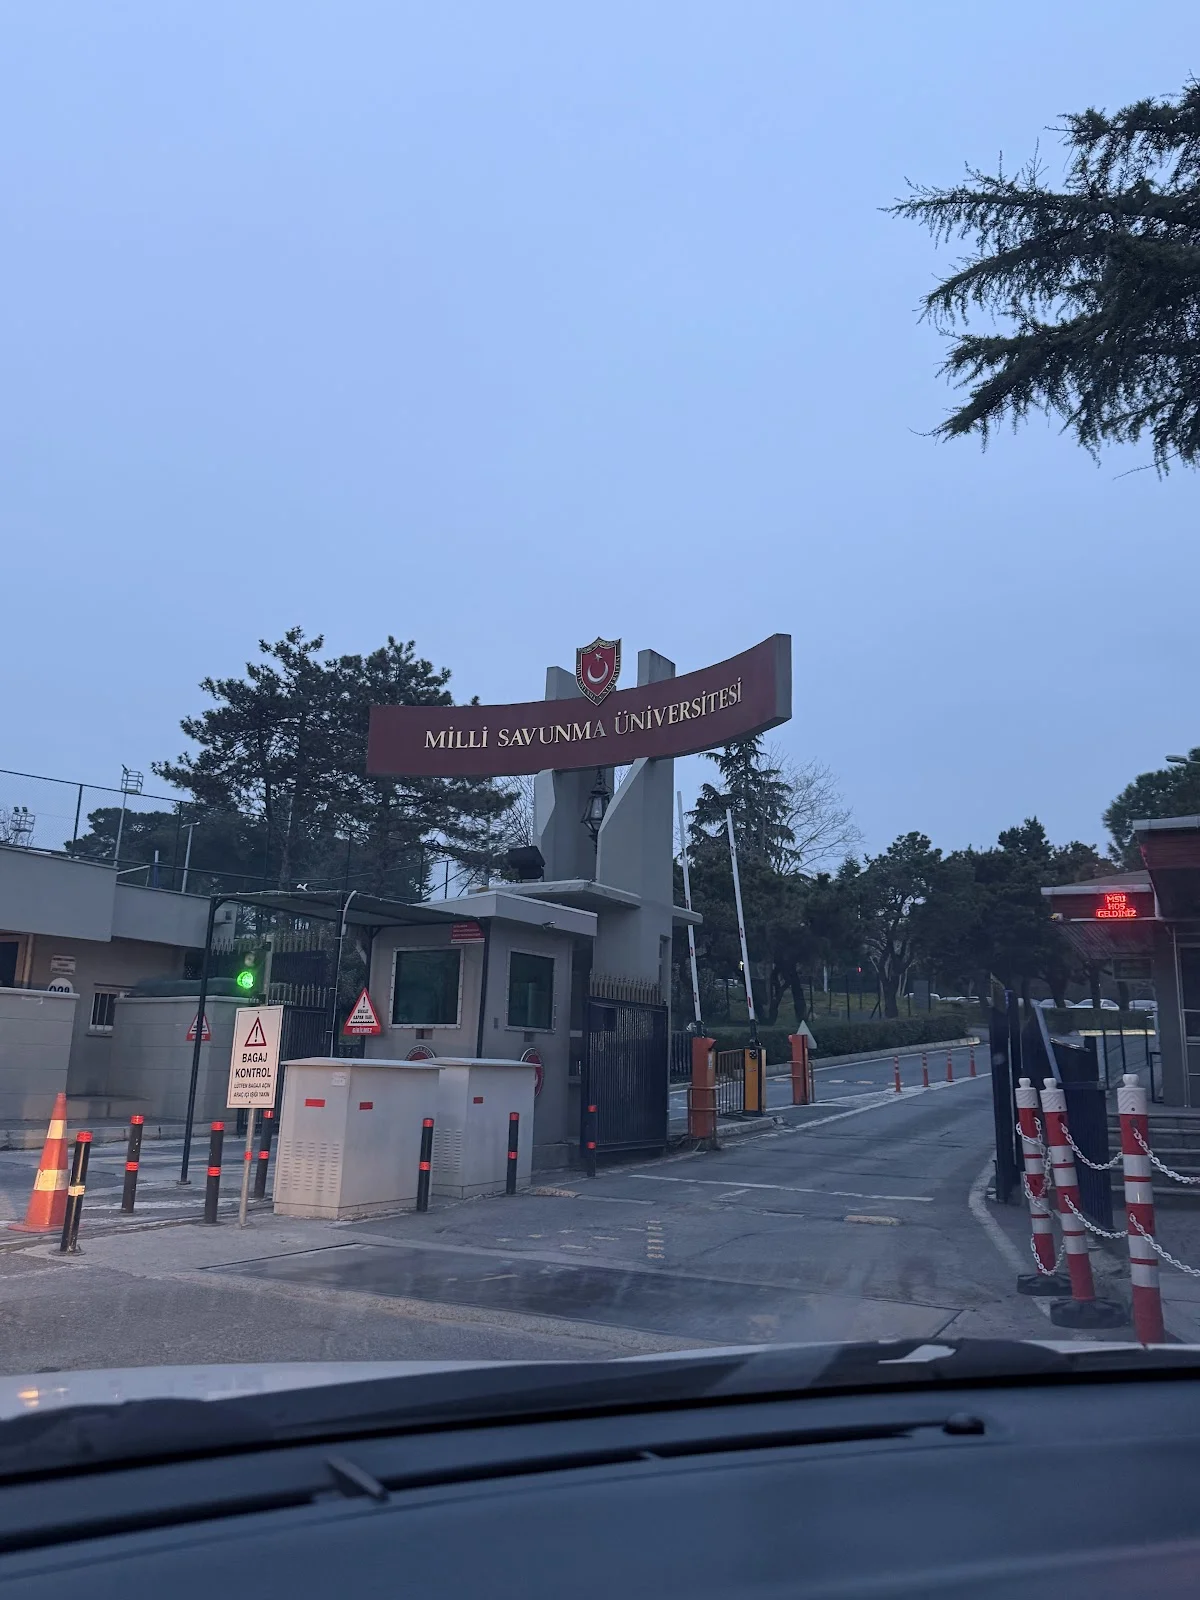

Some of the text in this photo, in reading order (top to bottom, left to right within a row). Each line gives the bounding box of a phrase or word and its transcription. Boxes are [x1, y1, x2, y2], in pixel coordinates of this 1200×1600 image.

[424, 726, 489, 749] MİLLİ
[497, 720, 607, 748] SAVUNMA
[614, 677, 743, 735] ÜNİVERSİTESİ
[242, 1053, 268, 1062] BAGAJ
[235, 1068, 271, 1078] KONTROL
